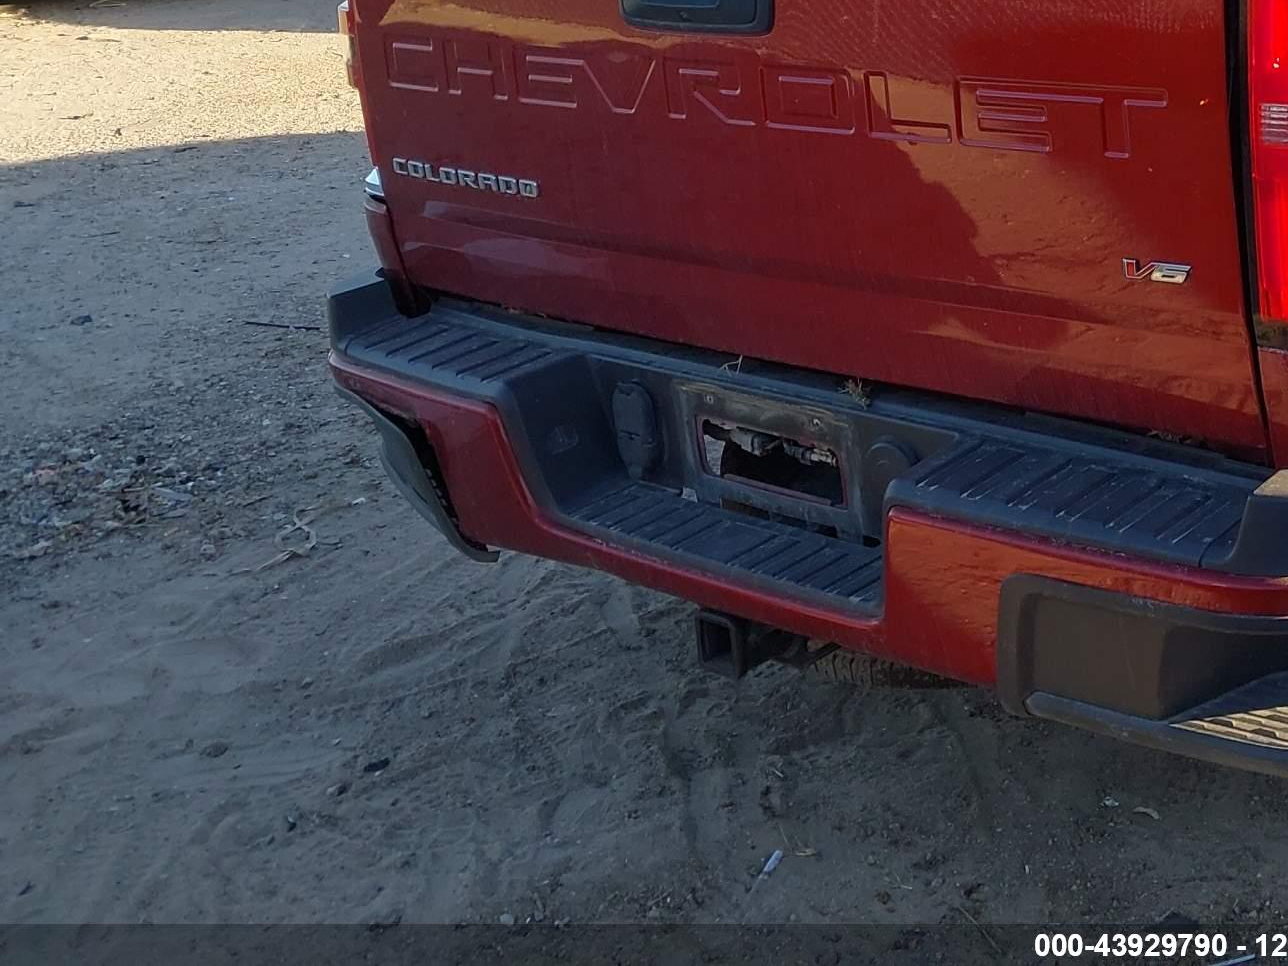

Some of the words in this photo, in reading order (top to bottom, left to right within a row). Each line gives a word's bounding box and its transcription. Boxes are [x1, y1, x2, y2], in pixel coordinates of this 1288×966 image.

[384, 34, 1168, 158] CHEVROLET
[393, 157, 538, 198] COLORADO
[1122, 258, 1192, 284] V6
